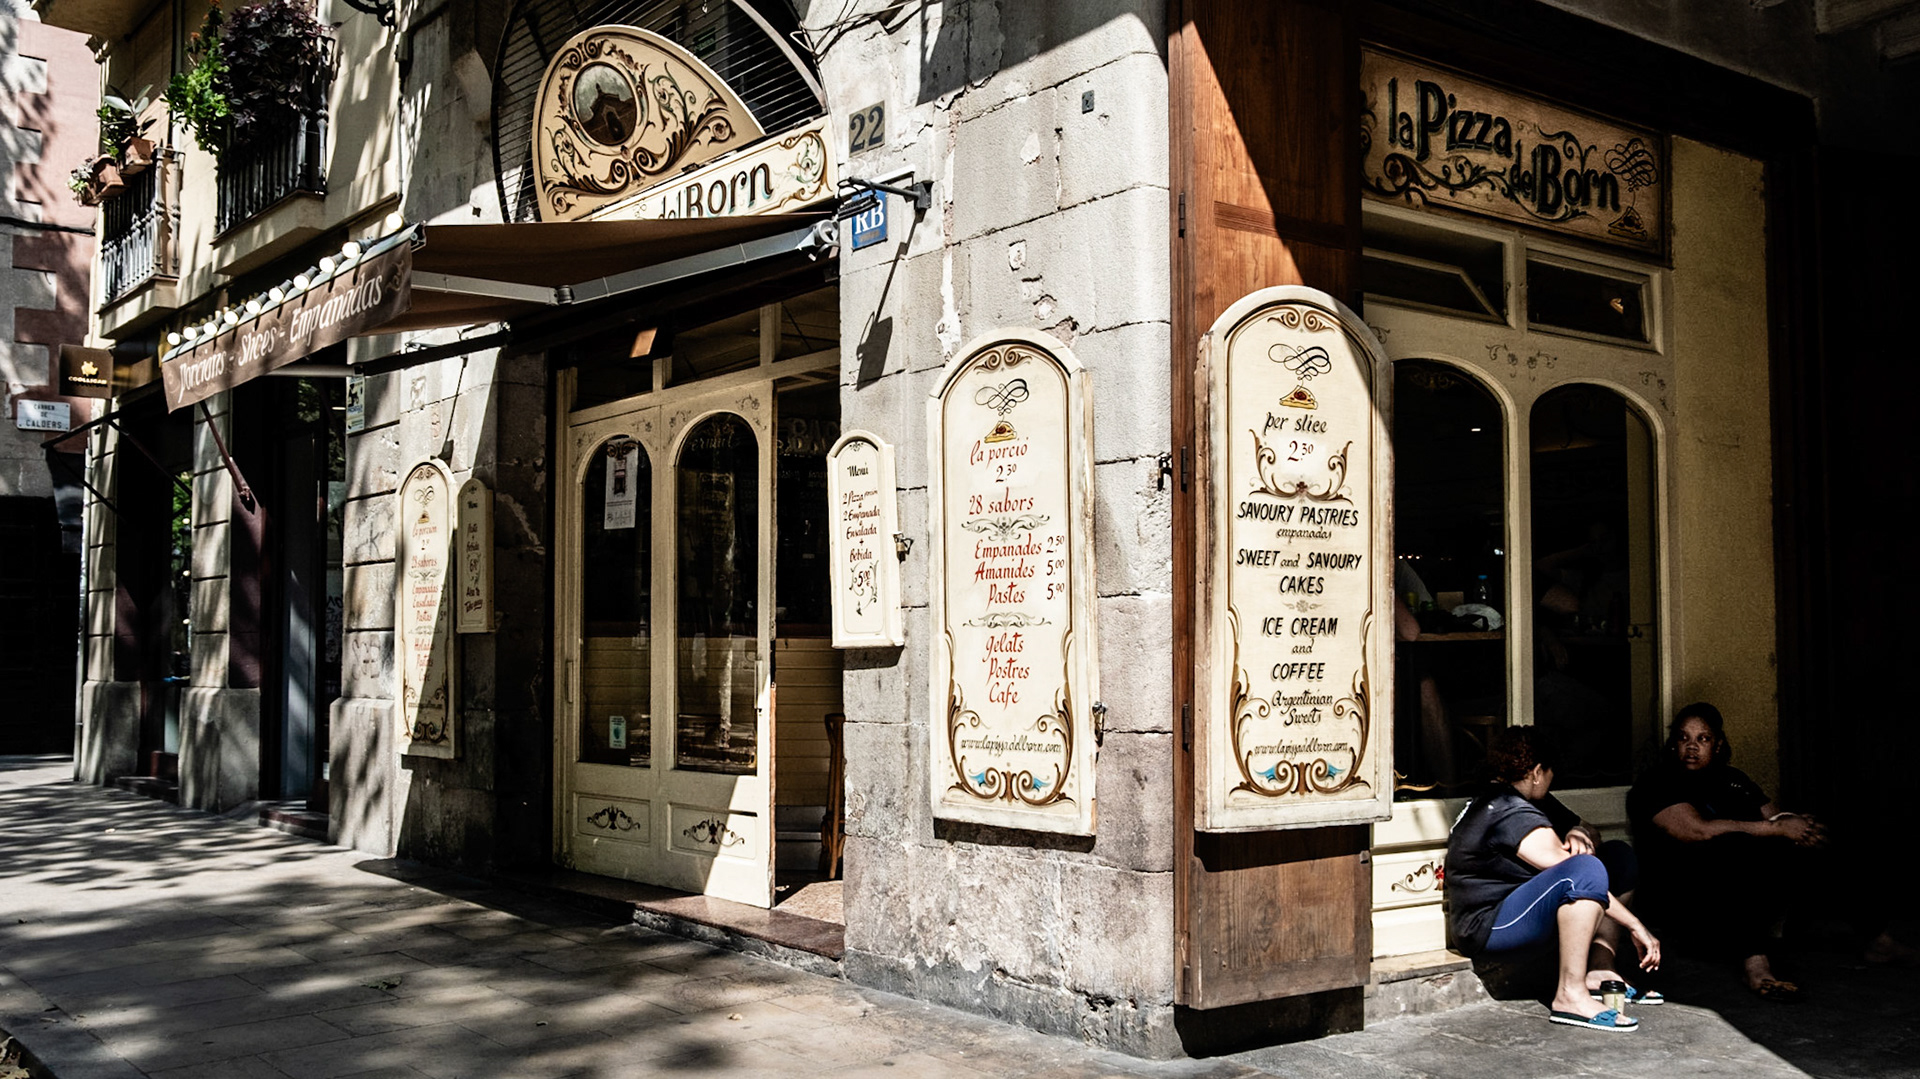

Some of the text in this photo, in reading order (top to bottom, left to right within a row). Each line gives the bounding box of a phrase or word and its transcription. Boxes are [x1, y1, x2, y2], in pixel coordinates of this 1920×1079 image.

[851, 106, 884, 150] 22
[1388, 78, 1512, 161] la Pizza
[1510, 140, 1620, 214] del Born
[685, 163, 773, 217] Born
[238, 326, 277, 367] Slices
[290, 274, 383, 347] Empanadas
[25, 419, 62, 429] CALDERS
[1264, 412, 1328, 435] per slice
[969, 487, 1034, 515] 28 sabors
[1237, 501, 1359, 527] SAVOURY PASTRIES
[846, 523, 877, 540] Ensalada
[1276, 527, 1332, 543] empanadas
[974, 533, 1042, 565] Empanades
[1236, 548, 1362, 569] SWEET and SAVOURY
[974, 558, 1035, 585] Amanides
[986, 582, 1025, 611] Pastes
[1279, 576, 1324, 594] CAKES
[1262, 617, 1338, 636] ICE CREAM
[1292, 639, 1314, 654] and
[986, 656, 1030, 686] Postres
[1272, 663, 1326, 680] COFFEE
[1271, 689, 1333, 714] Argentinian
[1284, 708, 1322, 726] Sweets
